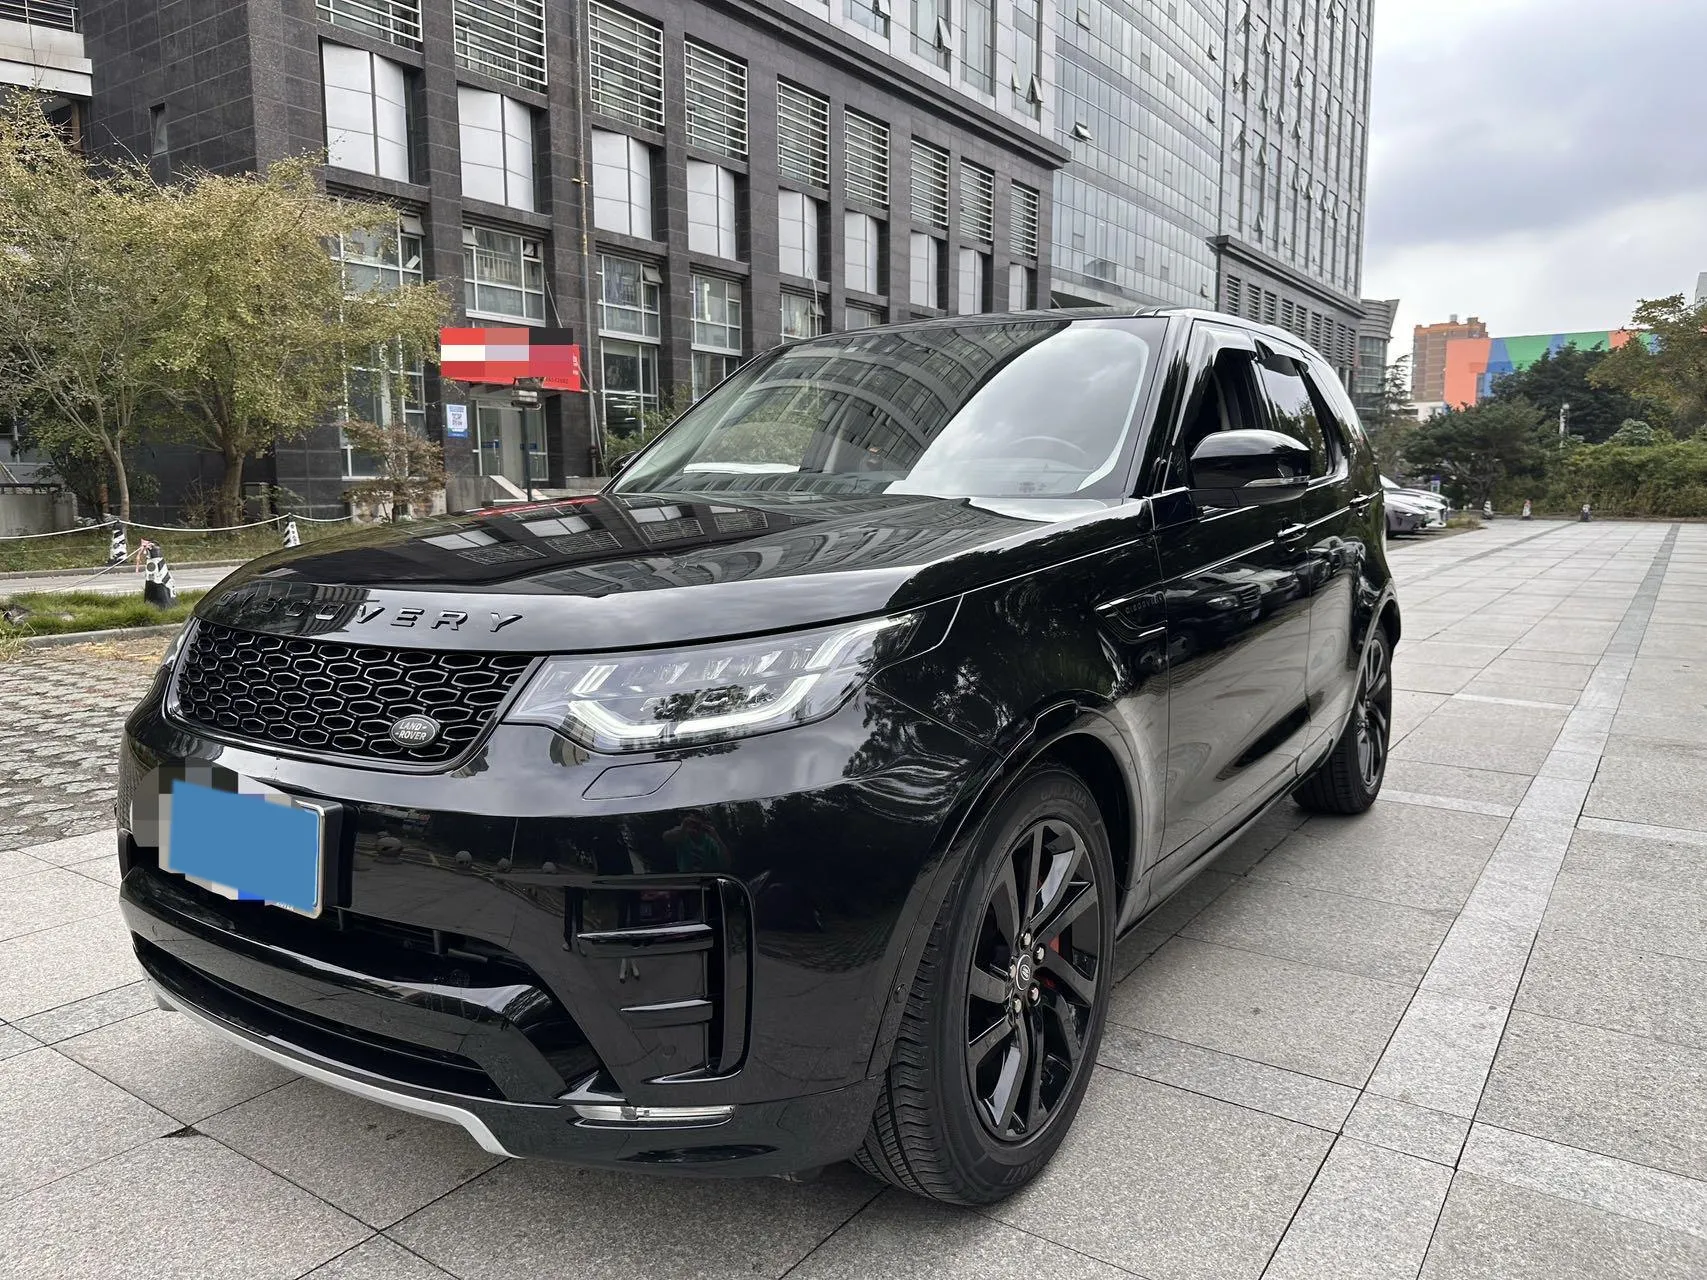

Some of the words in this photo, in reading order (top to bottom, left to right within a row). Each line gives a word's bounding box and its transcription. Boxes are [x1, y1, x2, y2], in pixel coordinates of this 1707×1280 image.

[215, 591, 524, 633] DISCOVERY
[399, 721, 423, 731] LAND
[398, 730, 427, 740] ROVER
